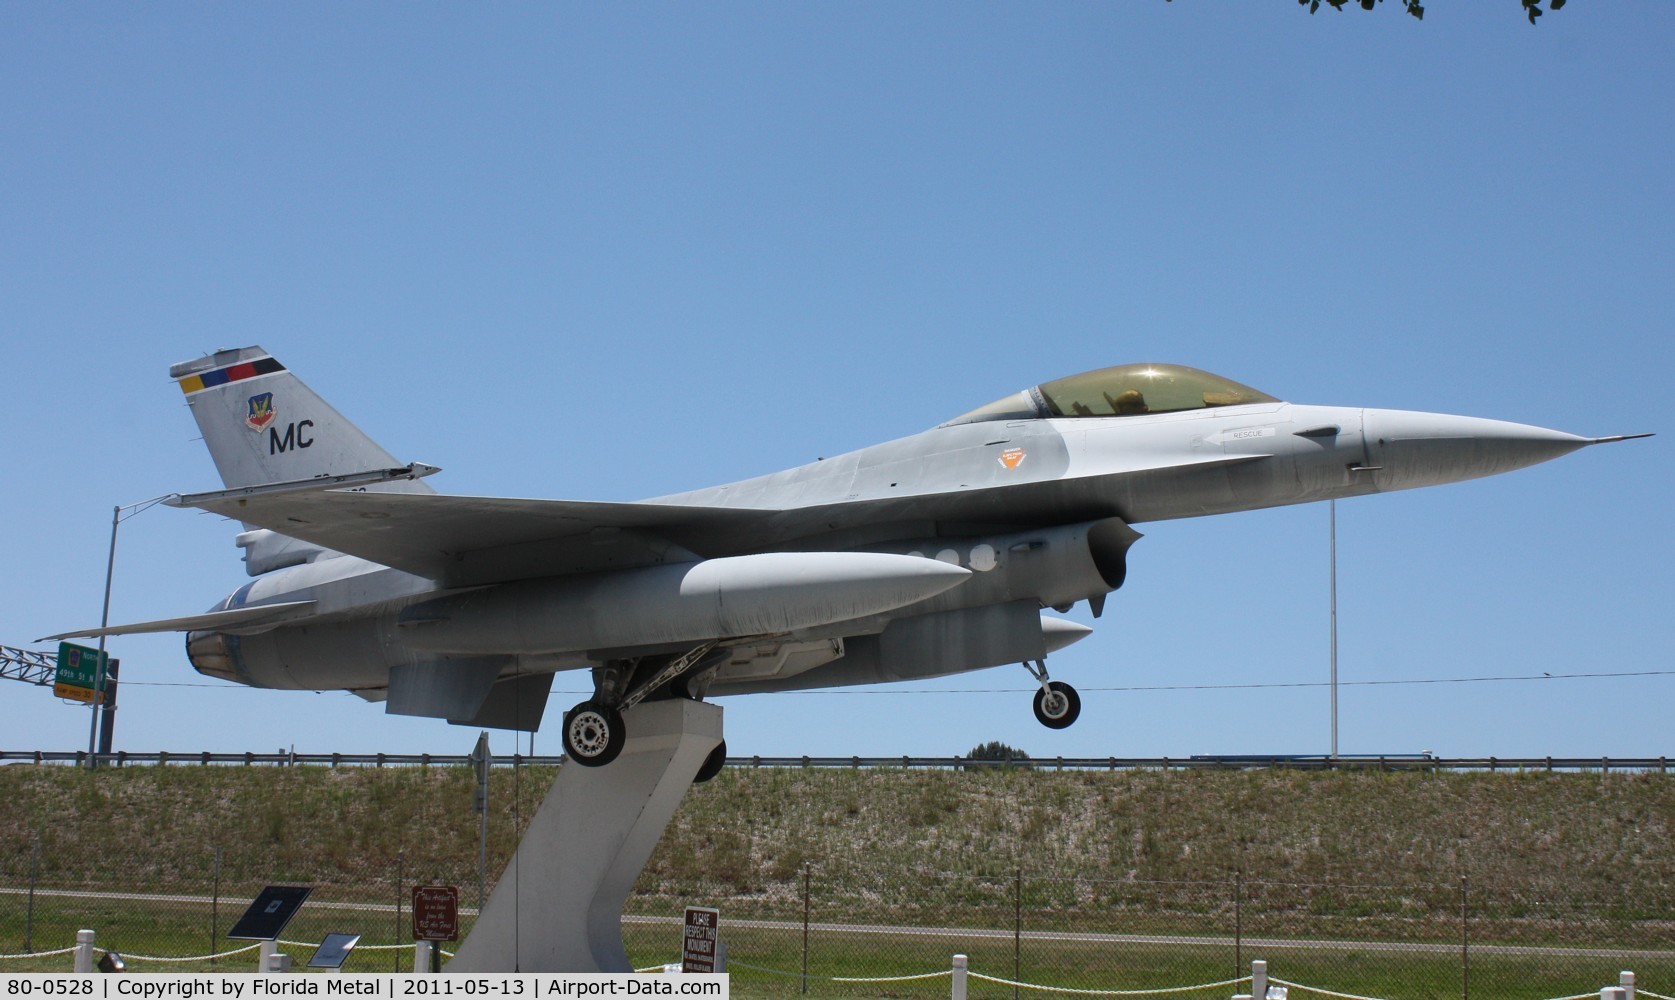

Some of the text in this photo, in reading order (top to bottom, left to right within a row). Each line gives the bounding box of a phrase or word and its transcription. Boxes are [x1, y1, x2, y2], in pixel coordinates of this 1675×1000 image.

[270, 419, 314, 455] MC
[1233, 430, 1263, 439] RESCUE
[59, 668, 74, 678] 49th
[78, 672, 85, 681] St
[693, 912, 710, 926] PLEASE
[685, 924, 716, 941] RESPECT THIS
[687, 938, 712, 952] MONUMENT
